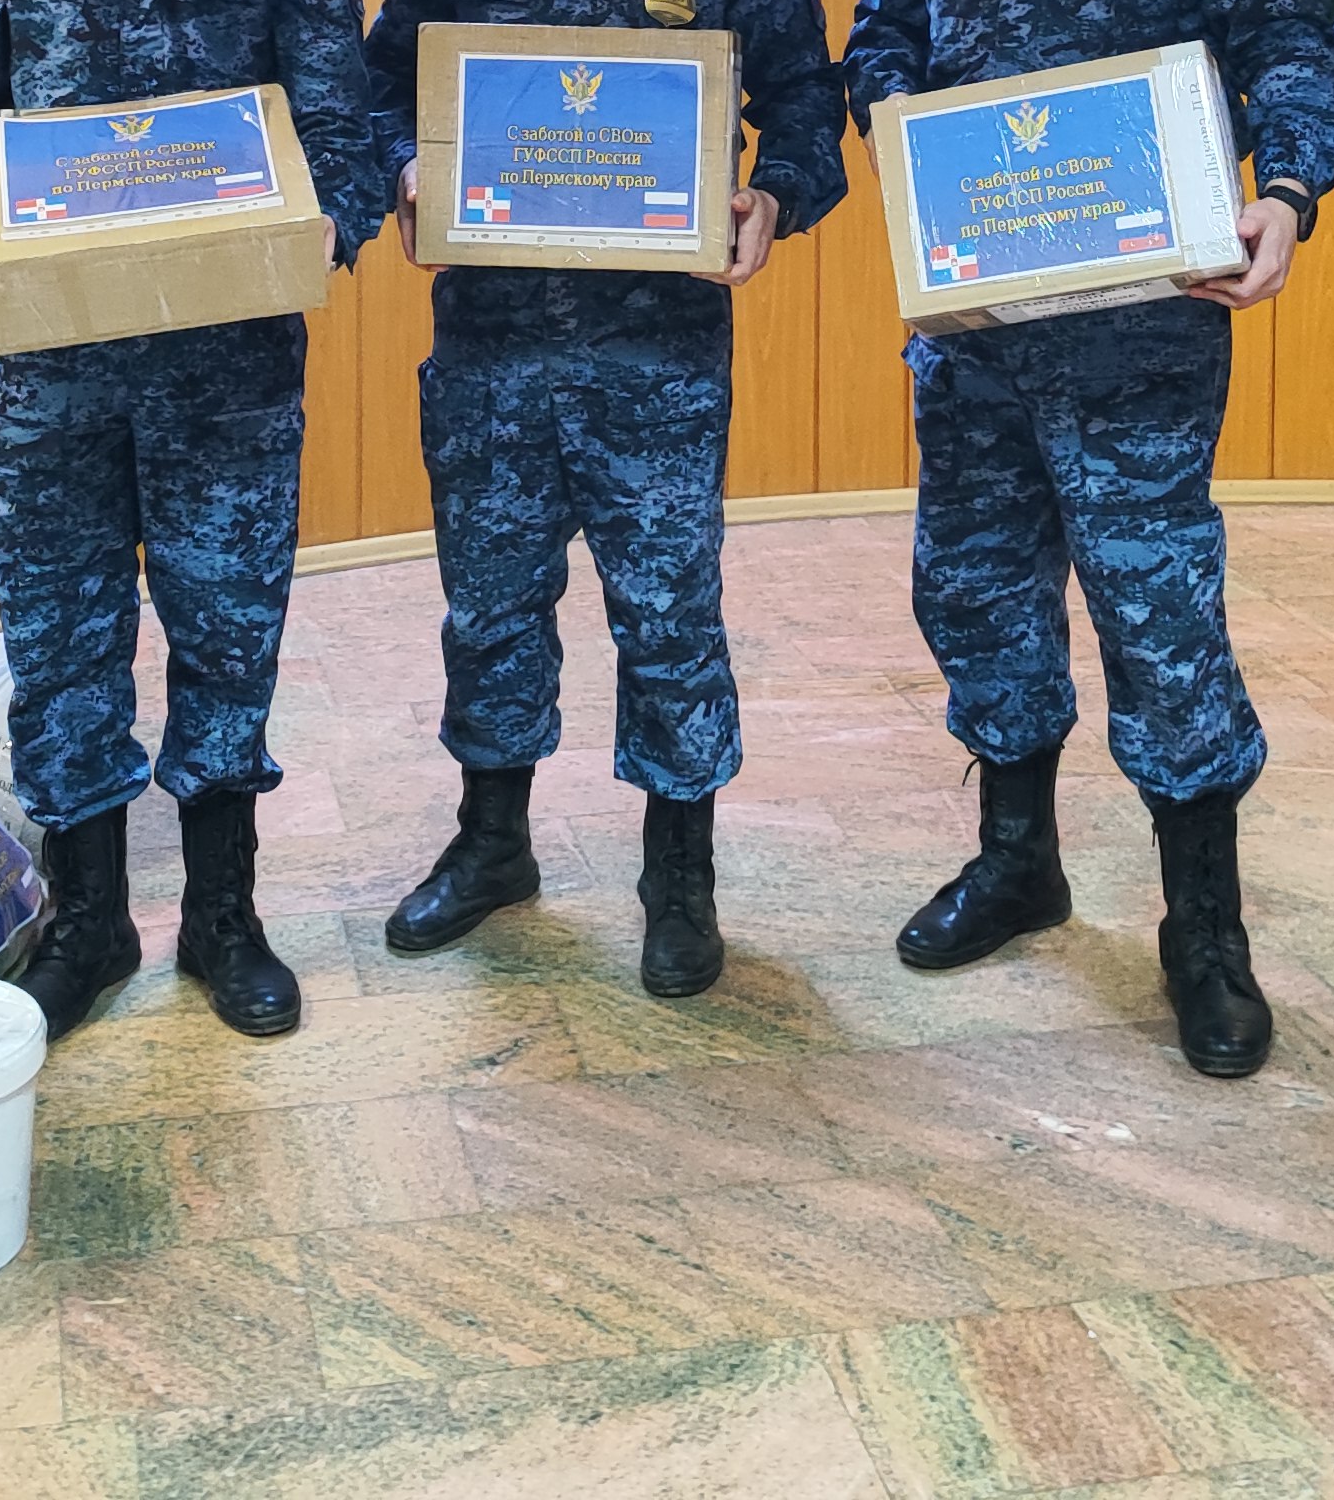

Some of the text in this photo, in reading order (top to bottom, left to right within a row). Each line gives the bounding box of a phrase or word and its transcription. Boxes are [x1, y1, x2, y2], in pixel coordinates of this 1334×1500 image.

[507, 125, 653, 144] С заботой о СВОих
[55, 140, 216, 168] С заботой о СВОих
[64, 155, 206, 180] ГУФССП России
[513, 147, 642, 165] ГУФССП России
[51, 166, 227, 196] по Пермскому краю
[499, 169, 657, 191] по Пермскому краю
[960, 155, 1114, 193] С заботой о СВОих
[970, 180, 1106, 214] ГУФССП России
[960, 200, 1126, 239] по Пермскому краю
